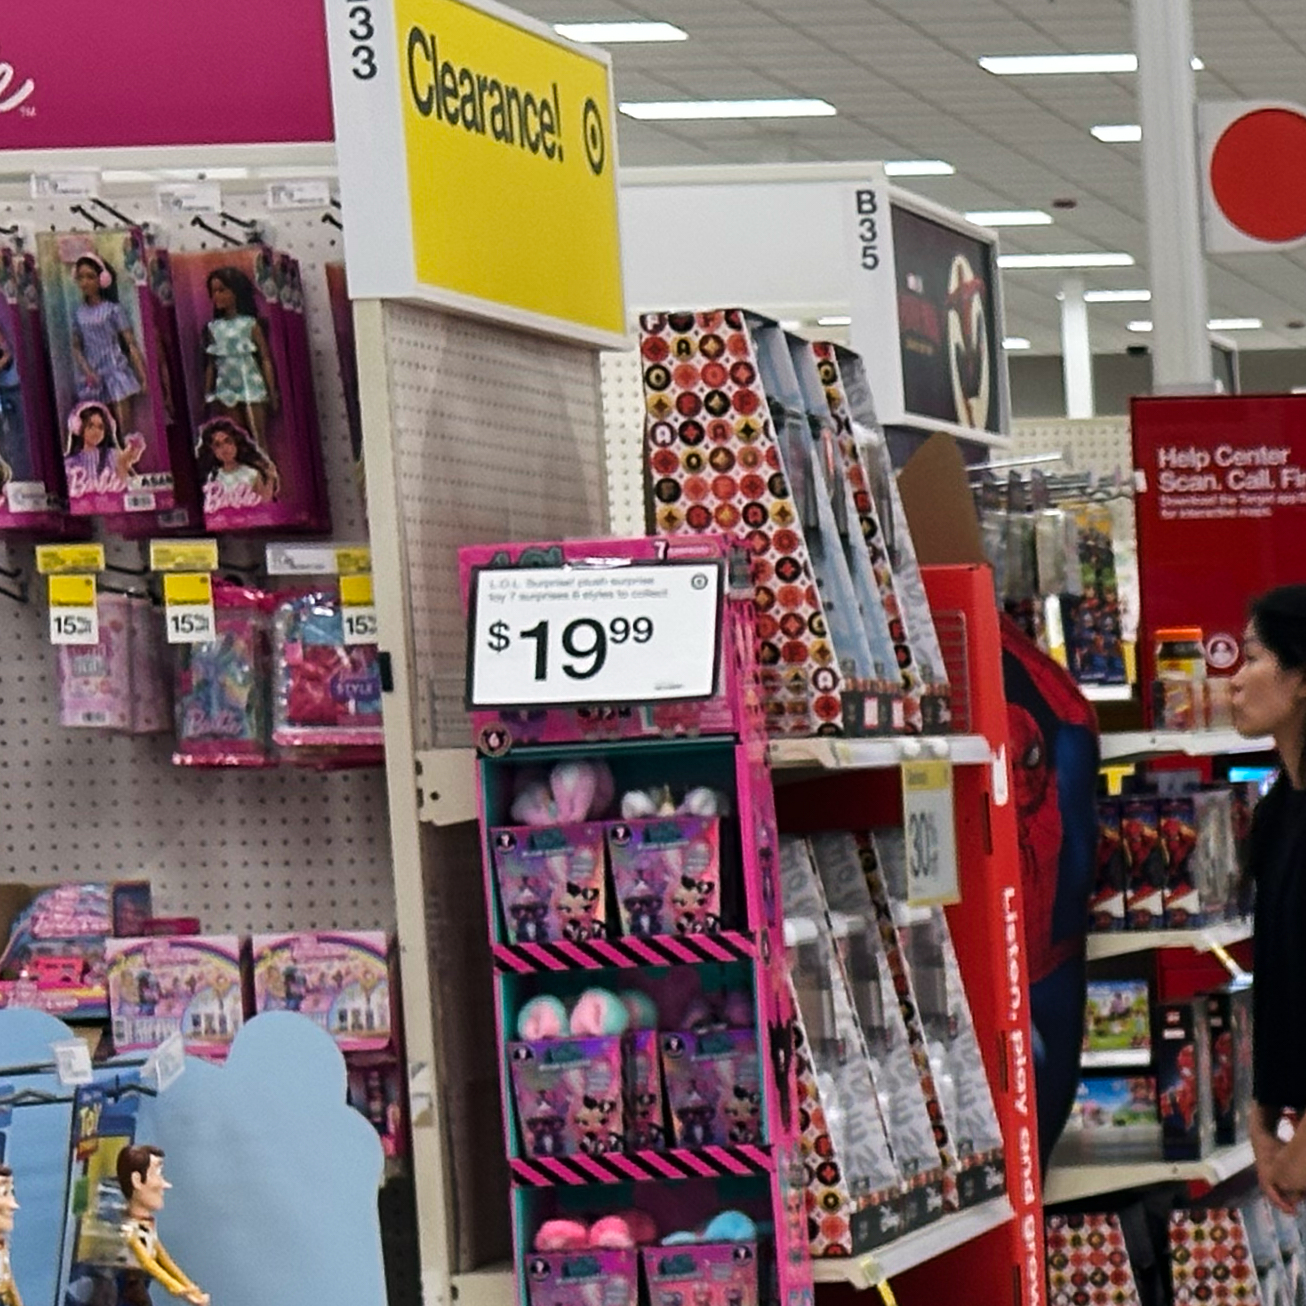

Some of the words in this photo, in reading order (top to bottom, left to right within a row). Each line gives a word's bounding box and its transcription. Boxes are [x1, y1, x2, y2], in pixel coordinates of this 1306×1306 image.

[406, 26, 564, 162] Clearance!
[1158, 446, 1211, 472] Help
[1214, 445, 1292, 468] Center
[1158, 470, 1223, 493] Scan.
[1226, 468, 1277, 490] Call.
[1009, 1029, 1031, 1115] play
[1019, 1126, 1037, 1205] and
